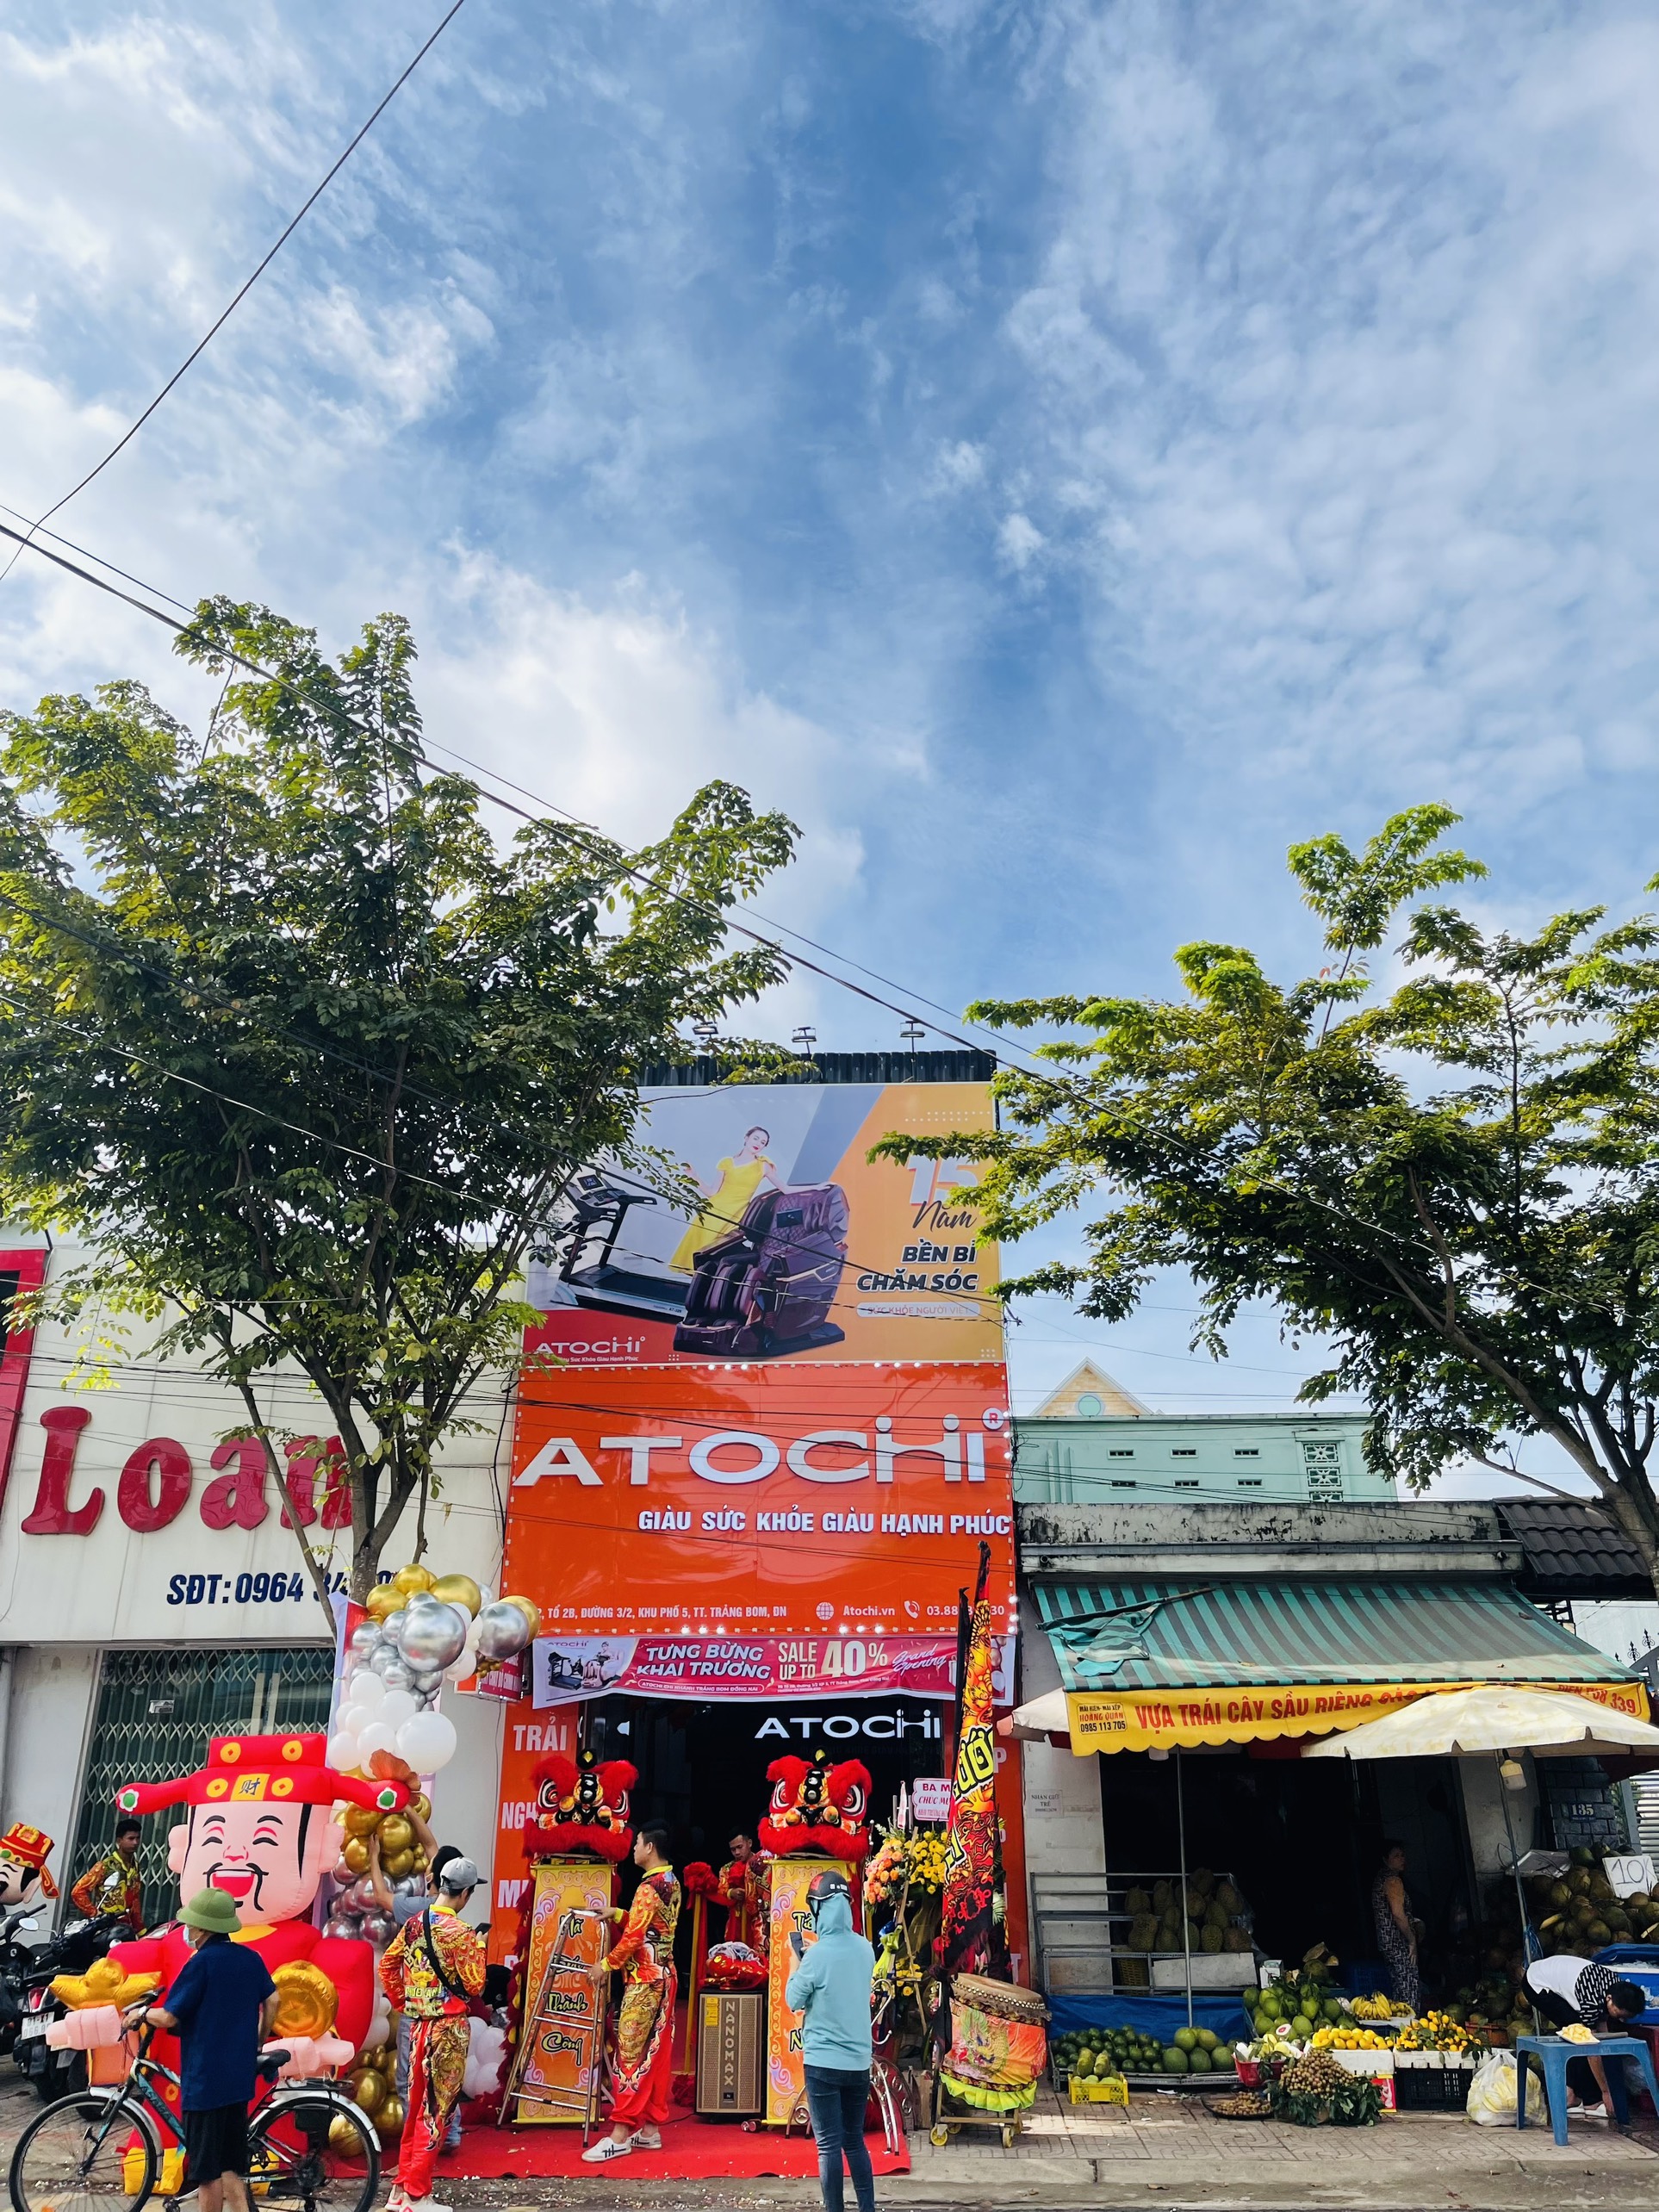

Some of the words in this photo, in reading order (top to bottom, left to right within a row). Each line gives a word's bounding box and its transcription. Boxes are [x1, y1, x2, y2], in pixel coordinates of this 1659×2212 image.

[907, 1154, 979, 1206] 15
[912, 1200, 977, 1233] Năm
[902, 1239, 950, 1264] BỀN
[856, 1268, 928, 1292] CHĂM
[930, 1267, 979, 1292] SÓC
[916, 1304, 948, 1314] NGƯỜI
[534, 1336, 641, 1354] ATOCHI
[513, 1414, 985, 1487] ATOCHI
[638, 1506, 692, 1532] GIÀU
[702, 1504, 747, 1532] SỨC
[757, 1504, 814, 1532] KHỎE
[822, 1506, 875, 1533] GIÀU
[881, 1513, 944, 1538] HẠNH
[950, 1508, 1010, 1535] PHÚC
[234, 1572, 304, 1603] 0964
[547, 1604, 560, 1619] TỔ
[562, 1607, 578, 1619] 2B,
[581, 1605, 613, 1619] ĐƯỜNG
[617, 1607, 636, 1619] 3/2,
[638, 1607, 657, 1619] KHU
[660, 1604, 680, 1619] PHỐ
[681, 1607, 691, 1619] 5,
[693, 1607, 708, 1619] TT.
[710, 1604, 743, 1618] TRẢNG
[745, 1606, 770, 1619] BOM,
[773, 1606, 787, 1617] ĐN
[842, 1605, 896, 1616] Atochi.vn
[646, 1644, 701, 1662] TƯNG
[705, 1640, 764, 1661] BỪNG
[778, 1642, 817, 1662] SALE
[892, 1643, 938, 1667] Grand
[637, 1662, 684, 1677] KHAI
[689, 1661, 772, 1680] TRƯƠNG
[780, 1664, 798, 1681] UP
[799, 1663, 817, 1679] TO
[893, 1656, 947, 1675] Opening
[1135, 1703, 1175, 1734] VỰA
[1178, 1698, 1221, 1726] TRÁI
[1227, 1695, 1264, 1724] CÂY
[1271, 1691, 1308, 1719] SẦU
[1314, 1690, 1373, 1713] RIÊNG
[513, 1716, 567, 1751] TRẢI
[754, 1708, 941, 1740] ATOCHI
[1080, 1723, 1097, 1732] 0985
[1099, 1722, 1112, 1731] 113
[1112, 1720, 1126, 1730] 705
[239, 1777, 261, 1796] 财
[923, 1783, 936, 1792] BA
[1572, 1804, 1594, 1816] 135
[544, 1991, 589, 2013] Thành
[541, 2031, 584, 2066] Công
[724, 2000, 736, 2086] NANOMAX
